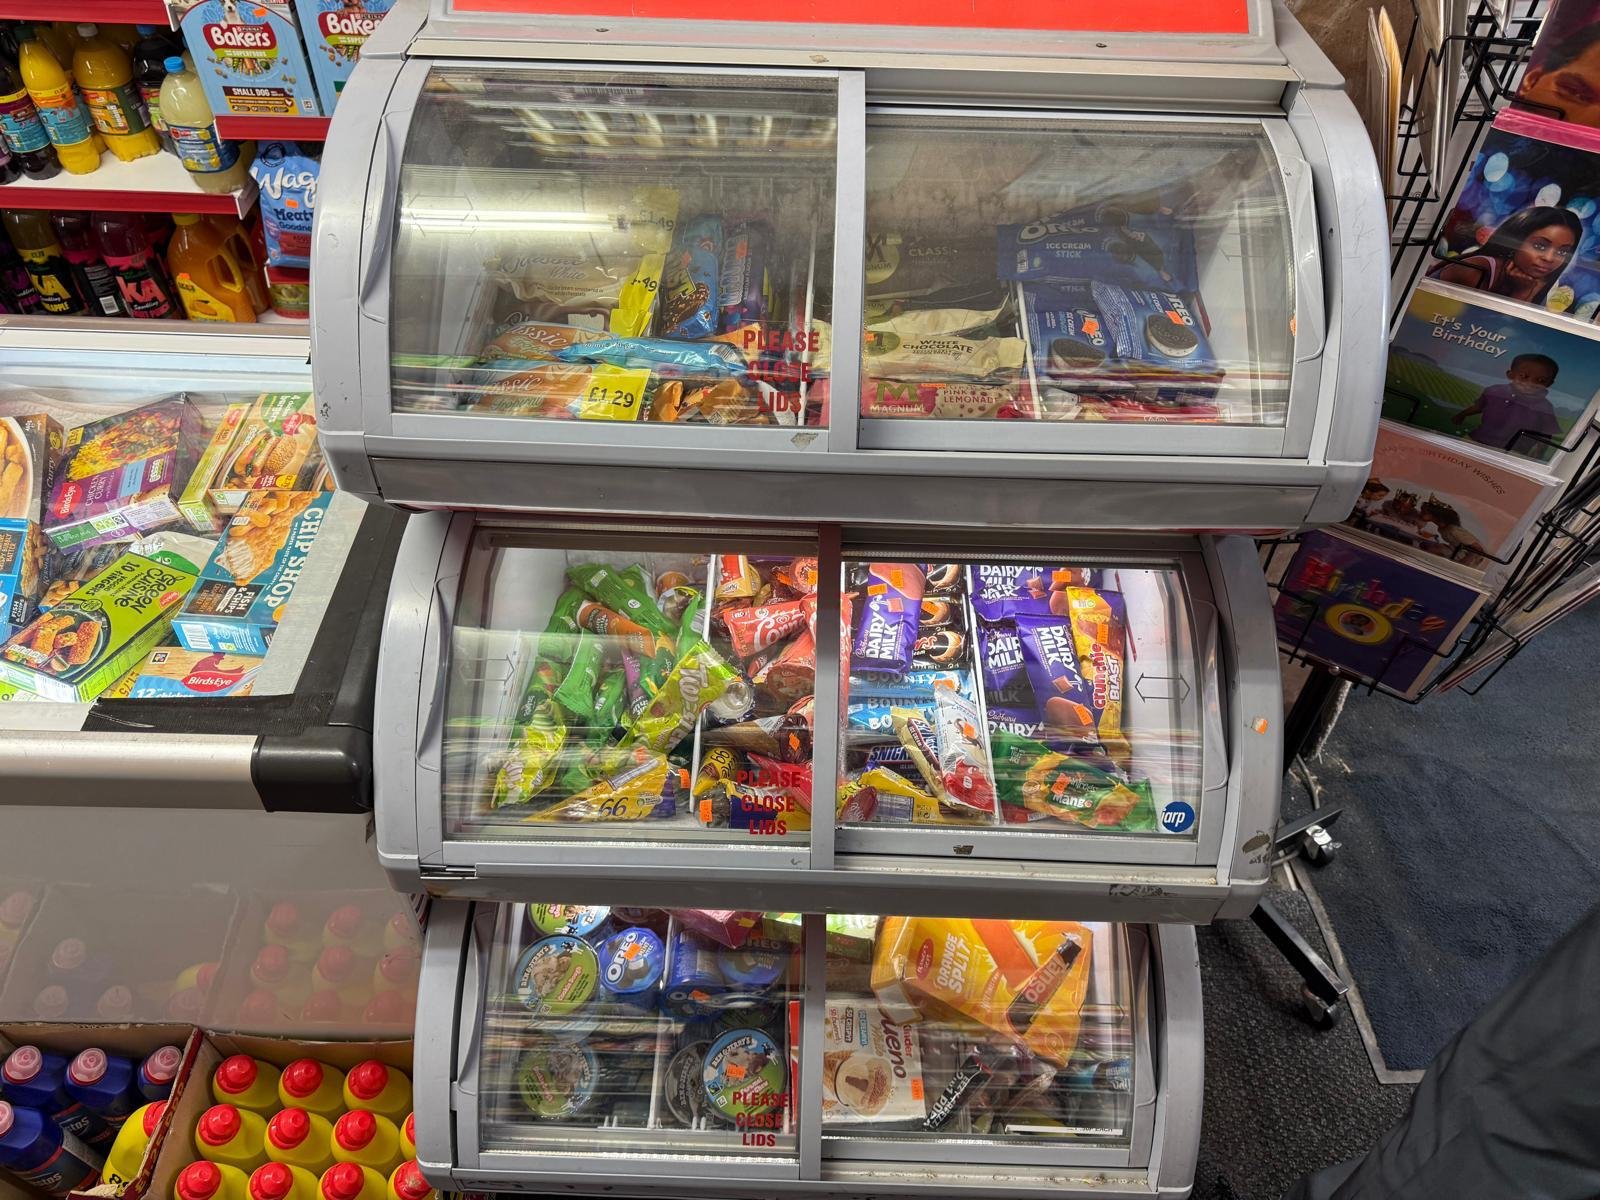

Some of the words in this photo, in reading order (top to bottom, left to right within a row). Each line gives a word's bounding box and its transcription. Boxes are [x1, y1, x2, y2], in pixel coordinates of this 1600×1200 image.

[210, 26, 270, 48] Bakers
[232, 87, 256, 96] SMALL
[256, 88, 271, 96] DOG
[116, 277, 168, 305] KA
[1428, 312, 1461, 332] It's
[1469, 323, 1508, 344] Your
[743, 329, 820, 353] PLEASE
[902, 343, 975, 354] CHOCOLATE
[1430, 328, 1508, 359] Birthday
[747, 360, 812, 383] CLOSE
[589, 386, 635, 408] £1.29
[757, 391, 802, 413] LIDS
[869, 404, 926, 414] MAGNUM
[46, 456, 57, 488] Curry
[1473, 469, 1506, 496] WISHES
[294, 507, 325, 553] CHIP
[120, 561, 141, 573] 10
[980, 565, 1025, 578] DAIRY
[264, 555, 305, 609] SHOP
[132, 573, 182, 615] GREEN
[225, 592, 247, 614] CHIPS
[240, 589, 255, 611] FISH
[865, 615, 886, 659] DAIRY
[879, 624, 899, 660] MILK
[988, 636, 1021, 652] DAIR
[1036, 626, 1057, 665] MILK
[989, 651, 1025, 669] MILK
[1049, 625, 1077, 673] DAIRY
[187, 675, 233, 687] BirdsEye
[1108, 655, 1120, 702] BLAST
[869, 713, 895, 730] BO
[989, 721, 1039, 736] DAIRY
[737, 770, 801, 788] PLEASE
[741, 795, 795, 812] CLOSE
[1052, 793, 1094, 809] Mango
[749, 820, 787, 835] LIDS
[1160, 810, 1186, 827] iarp
[606, 932, 638, 982] OREO
[936, 933, 958, 987] ORANGE
[948, 935, 973, 994] SPLIT
[1024, 953, 1072, 1003] Tango
[878, 1010, 908, 1080] ueno
[732, 1091, 789, 1107] PLEASE
[735, 1112, 784, 1128] CLOSE
[742, 1133, 776, 1147] LIDS
